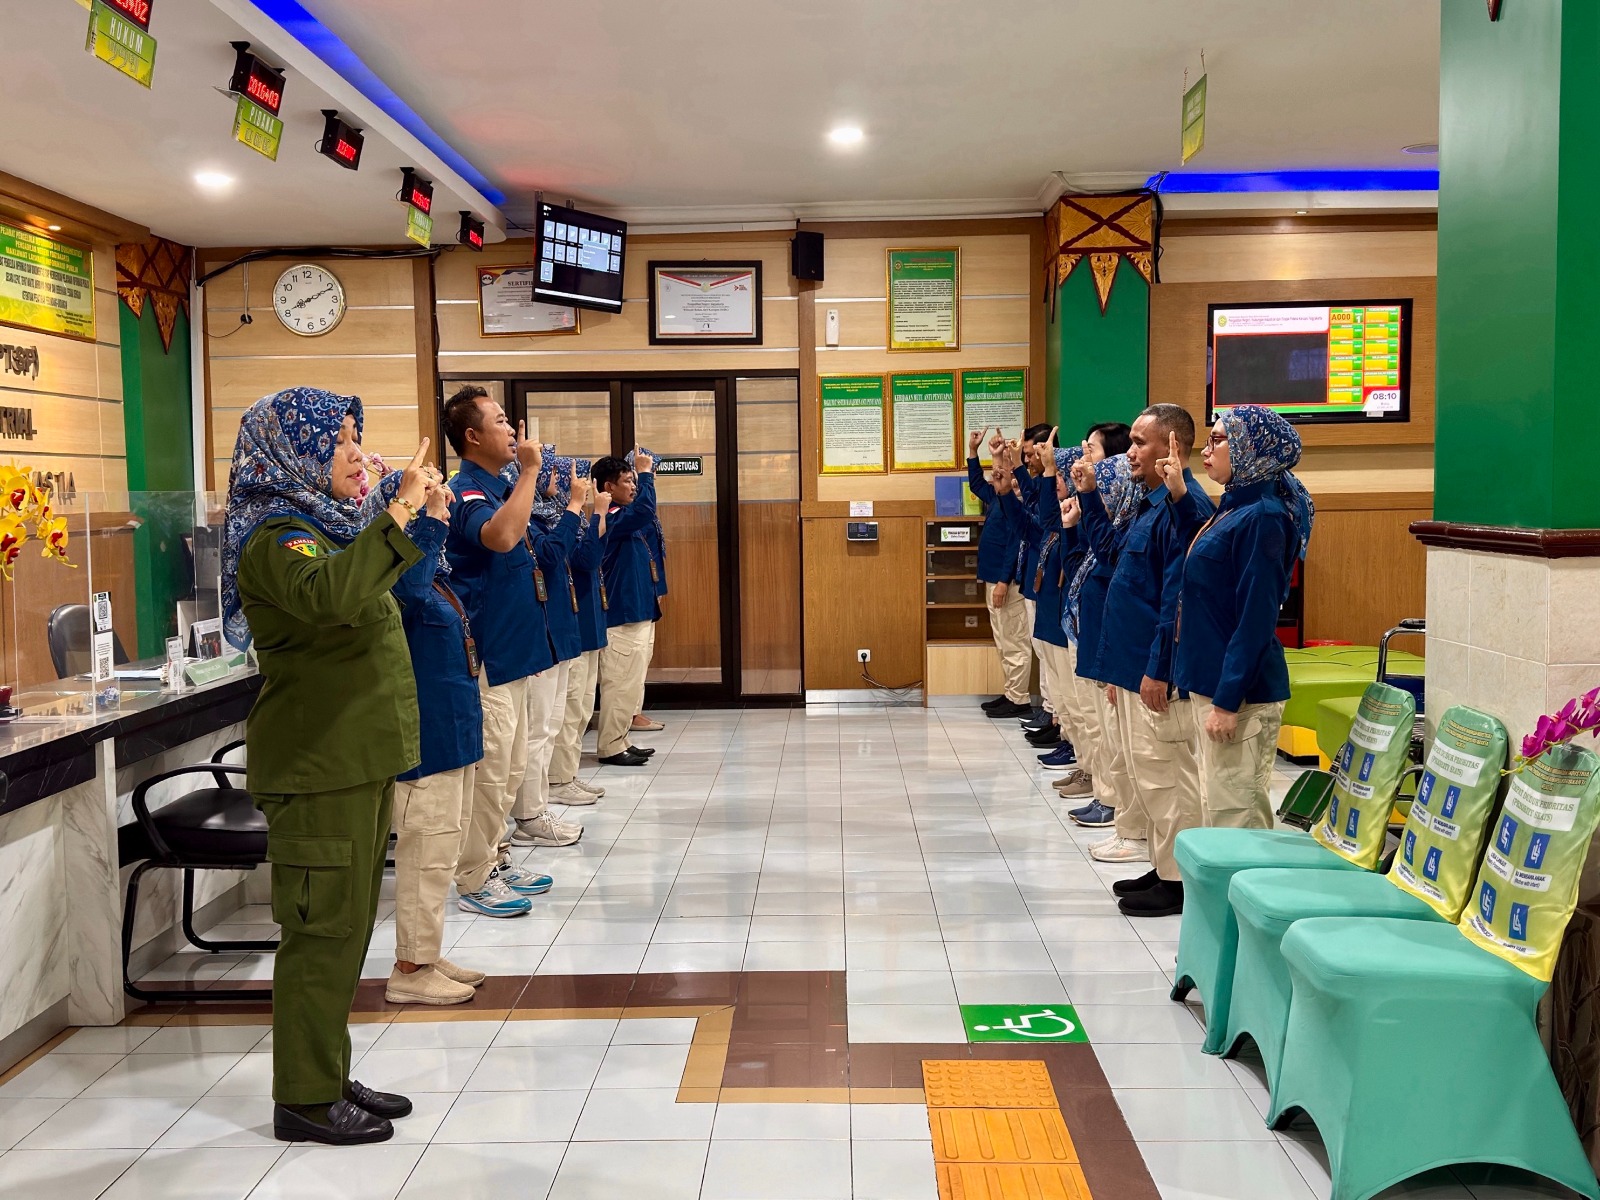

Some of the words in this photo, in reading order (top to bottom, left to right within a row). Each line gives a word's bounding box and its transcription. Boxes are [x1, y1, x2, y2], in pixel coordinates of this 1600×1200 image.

[109, 16, 144, 55] HUKUM
[249, 106, 275, 135] PIDANA
[292, 274, 298, 282] 11
[302, 270, 312, 279] 12
[283, 283, 292, 292] 10
[326, 282, 334, 291] 2
[280, 296, 286, 304] 9
[1356, 315, 1360, 324] 1
[307, 322, 314, 330] 6
[675, 461, 698, 470] PETUGAS
[1454, 754, 1480, 769] PRIORITAS
[1540, 800, 1574, 812] PRIORITAS
